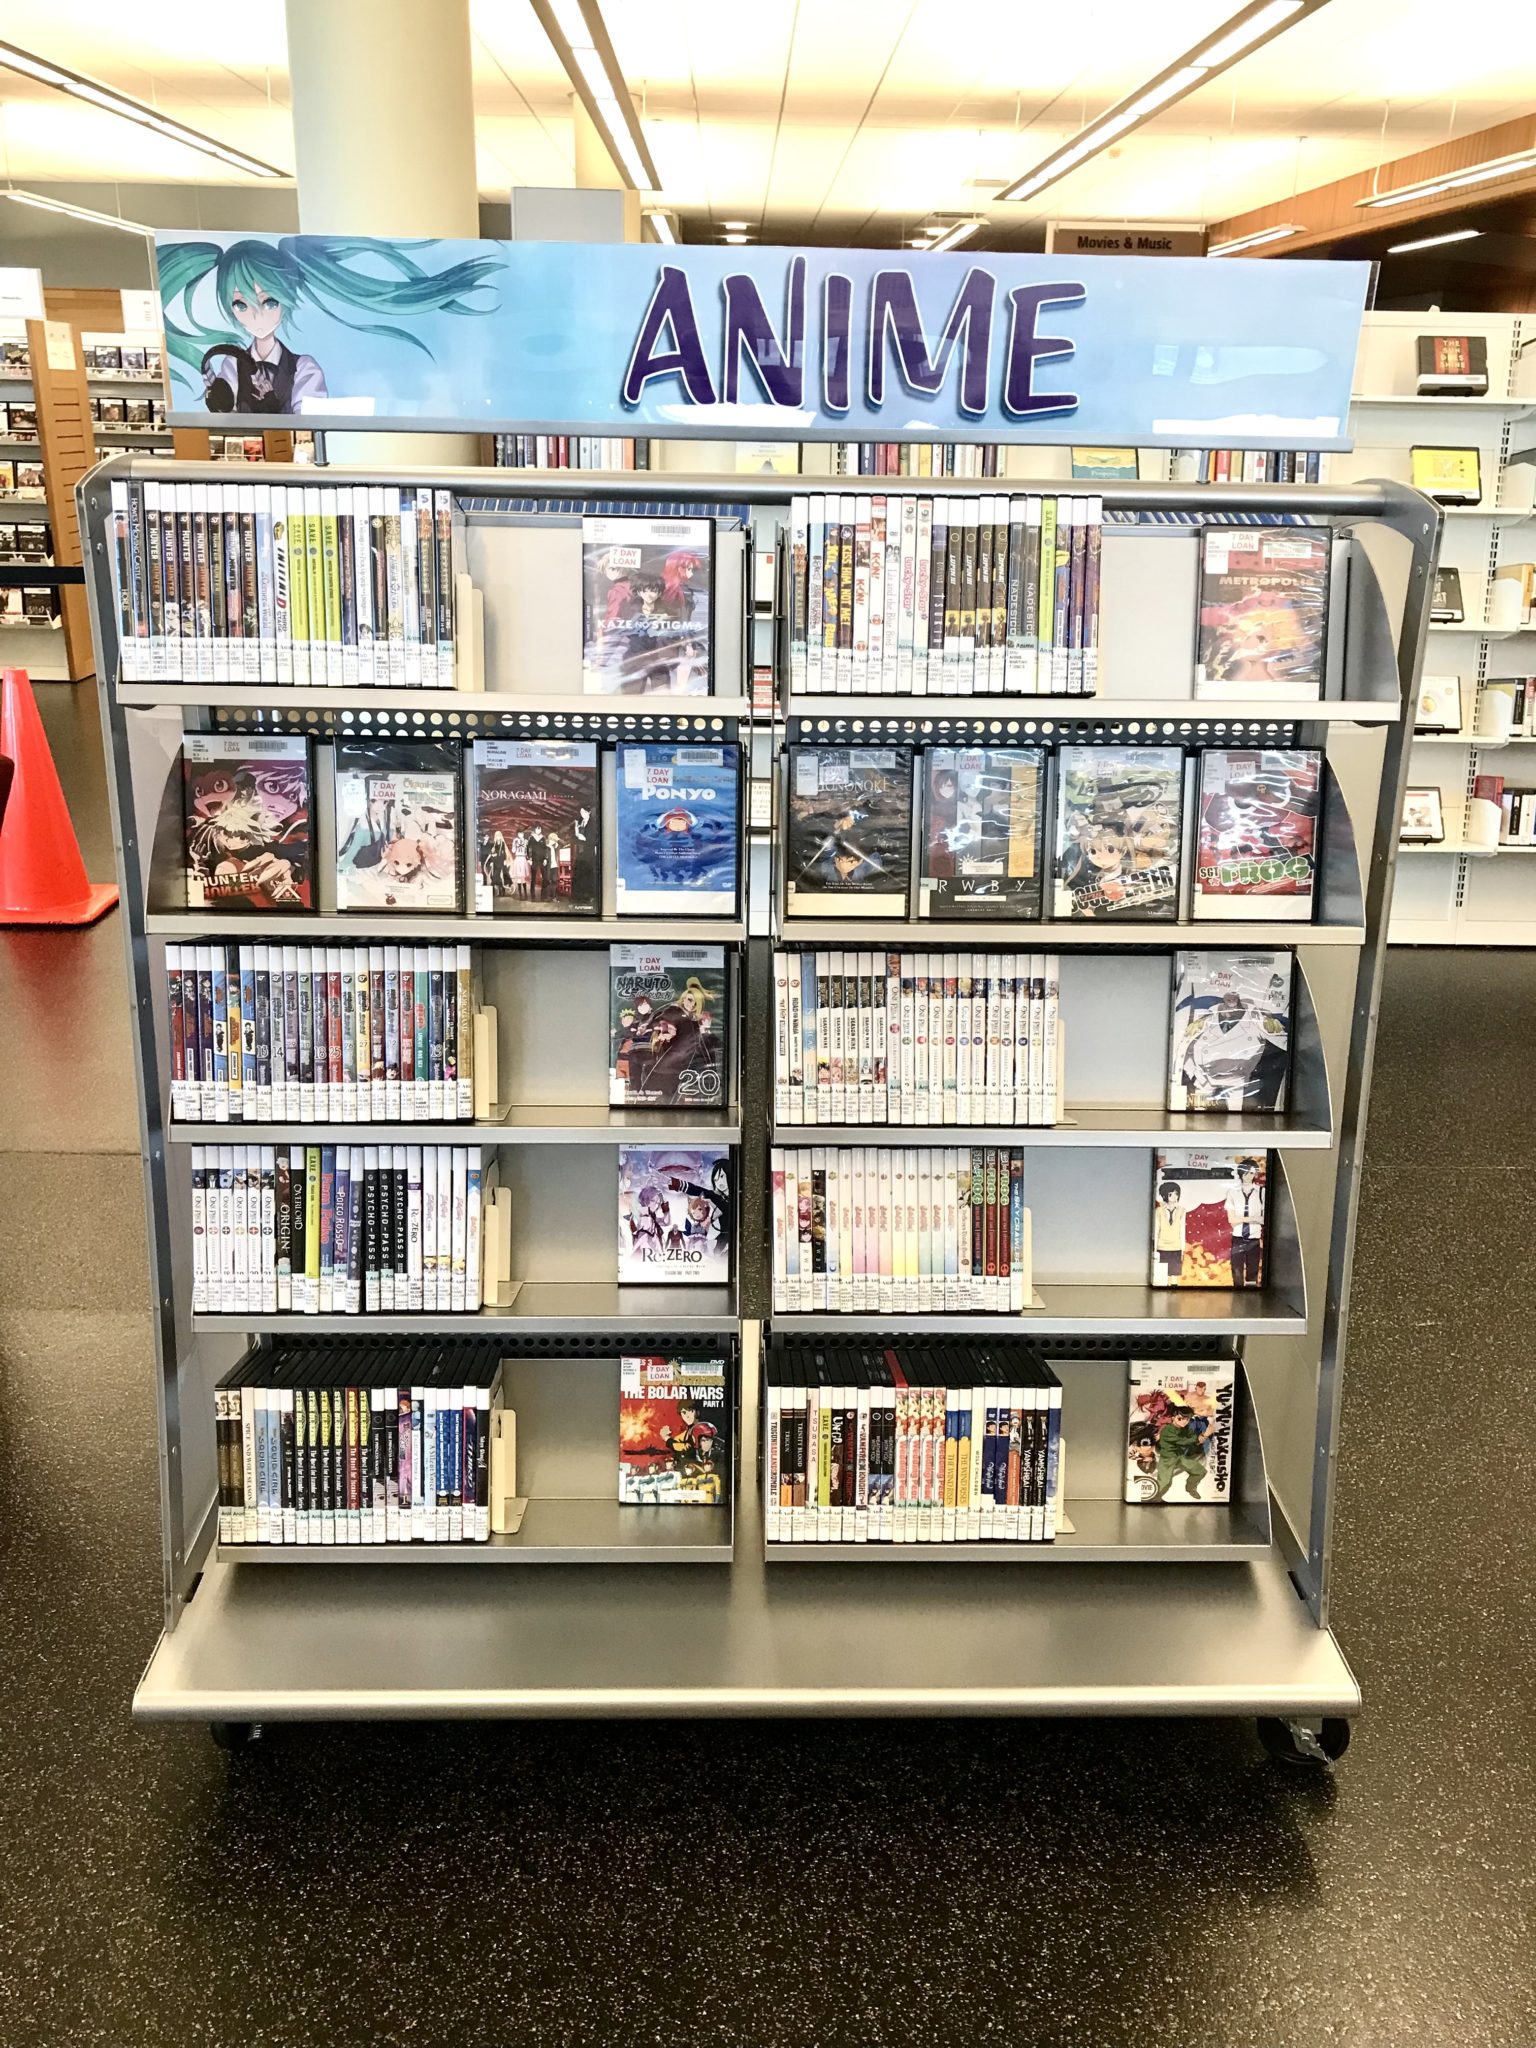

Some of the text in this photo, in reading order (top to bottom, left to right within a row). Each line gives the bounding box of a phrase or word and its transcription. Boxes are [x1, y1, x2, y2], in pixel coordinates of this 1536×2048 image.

[1077, 236, 1172, 250] Movies & Music
[619, 254, 1087, 420] ANIME
[150, 528, 158, 560] HUNTER
[165, 530, 174, 562] HUNTER
[182, 530, 190, 562] HUNTER
[197, 533, 205, 563] HUNTER
[244, 530, 253, 562] HUNTER
[620, 549, 638, 557] DAY
[841, 544, 852, 564] KISS
[612, 557, 637, 566] LOAN
[841, 588, 852, 605] NOT
[597, 619, 633, 630] KAZE
[652, 620, 703, 630] STIGMA
[380, 782, 397, 790] DAY
[646, 776, 670, 784] LOAN
[653, 768, 670, 776] DAY
[373, 790, 396, 798] LOAN
[482, 789, 548, 801] NORAGAMI
[641, 788, 717, 801] PONYO
[1199, 856, 1310, 888] SGT FROG
[615, 973, 672, 991] NARUTO
[1217, 972, 1233, 980] DAY
[272, 1046, 284, 1059] 14
[329, 1045, 342, 1060] 25
[678, 1068, 721, 1096] 20
[972, 1168, 983, 1205] FROG
[986, 1168, 996, 1205] FROG
[999, 1169, 1010, 1206] FROG
[293, 1183, 303, 1230] OVERLORD
[396, 1184, 404, 1250] PSYCHO-PASS
[279, 1204, 291, 1250] ORIGIN
[366, 1185, 376, 1261] PSYCHO-PASS
[381, 1185, 390, 1260] PSYCHO-PASS
[655, 1366, 670, 1374] DAY
[624, 1386, 724, 1400] THE BOLAR WARS
[702, 1400, 720, 1408] PART
[244, 1422, 252, 1440] SPICE
[257, 1436, 265, 1470] SQUID
[269, 1437, 278, 1471] SQUID
[858, 1433, 867, 1495] VAMPIRE KNIGHT
[947, 1454, 955, 1505] THE WIND RISES
[960, 1454, 968, 1504] THE WIND RISES
